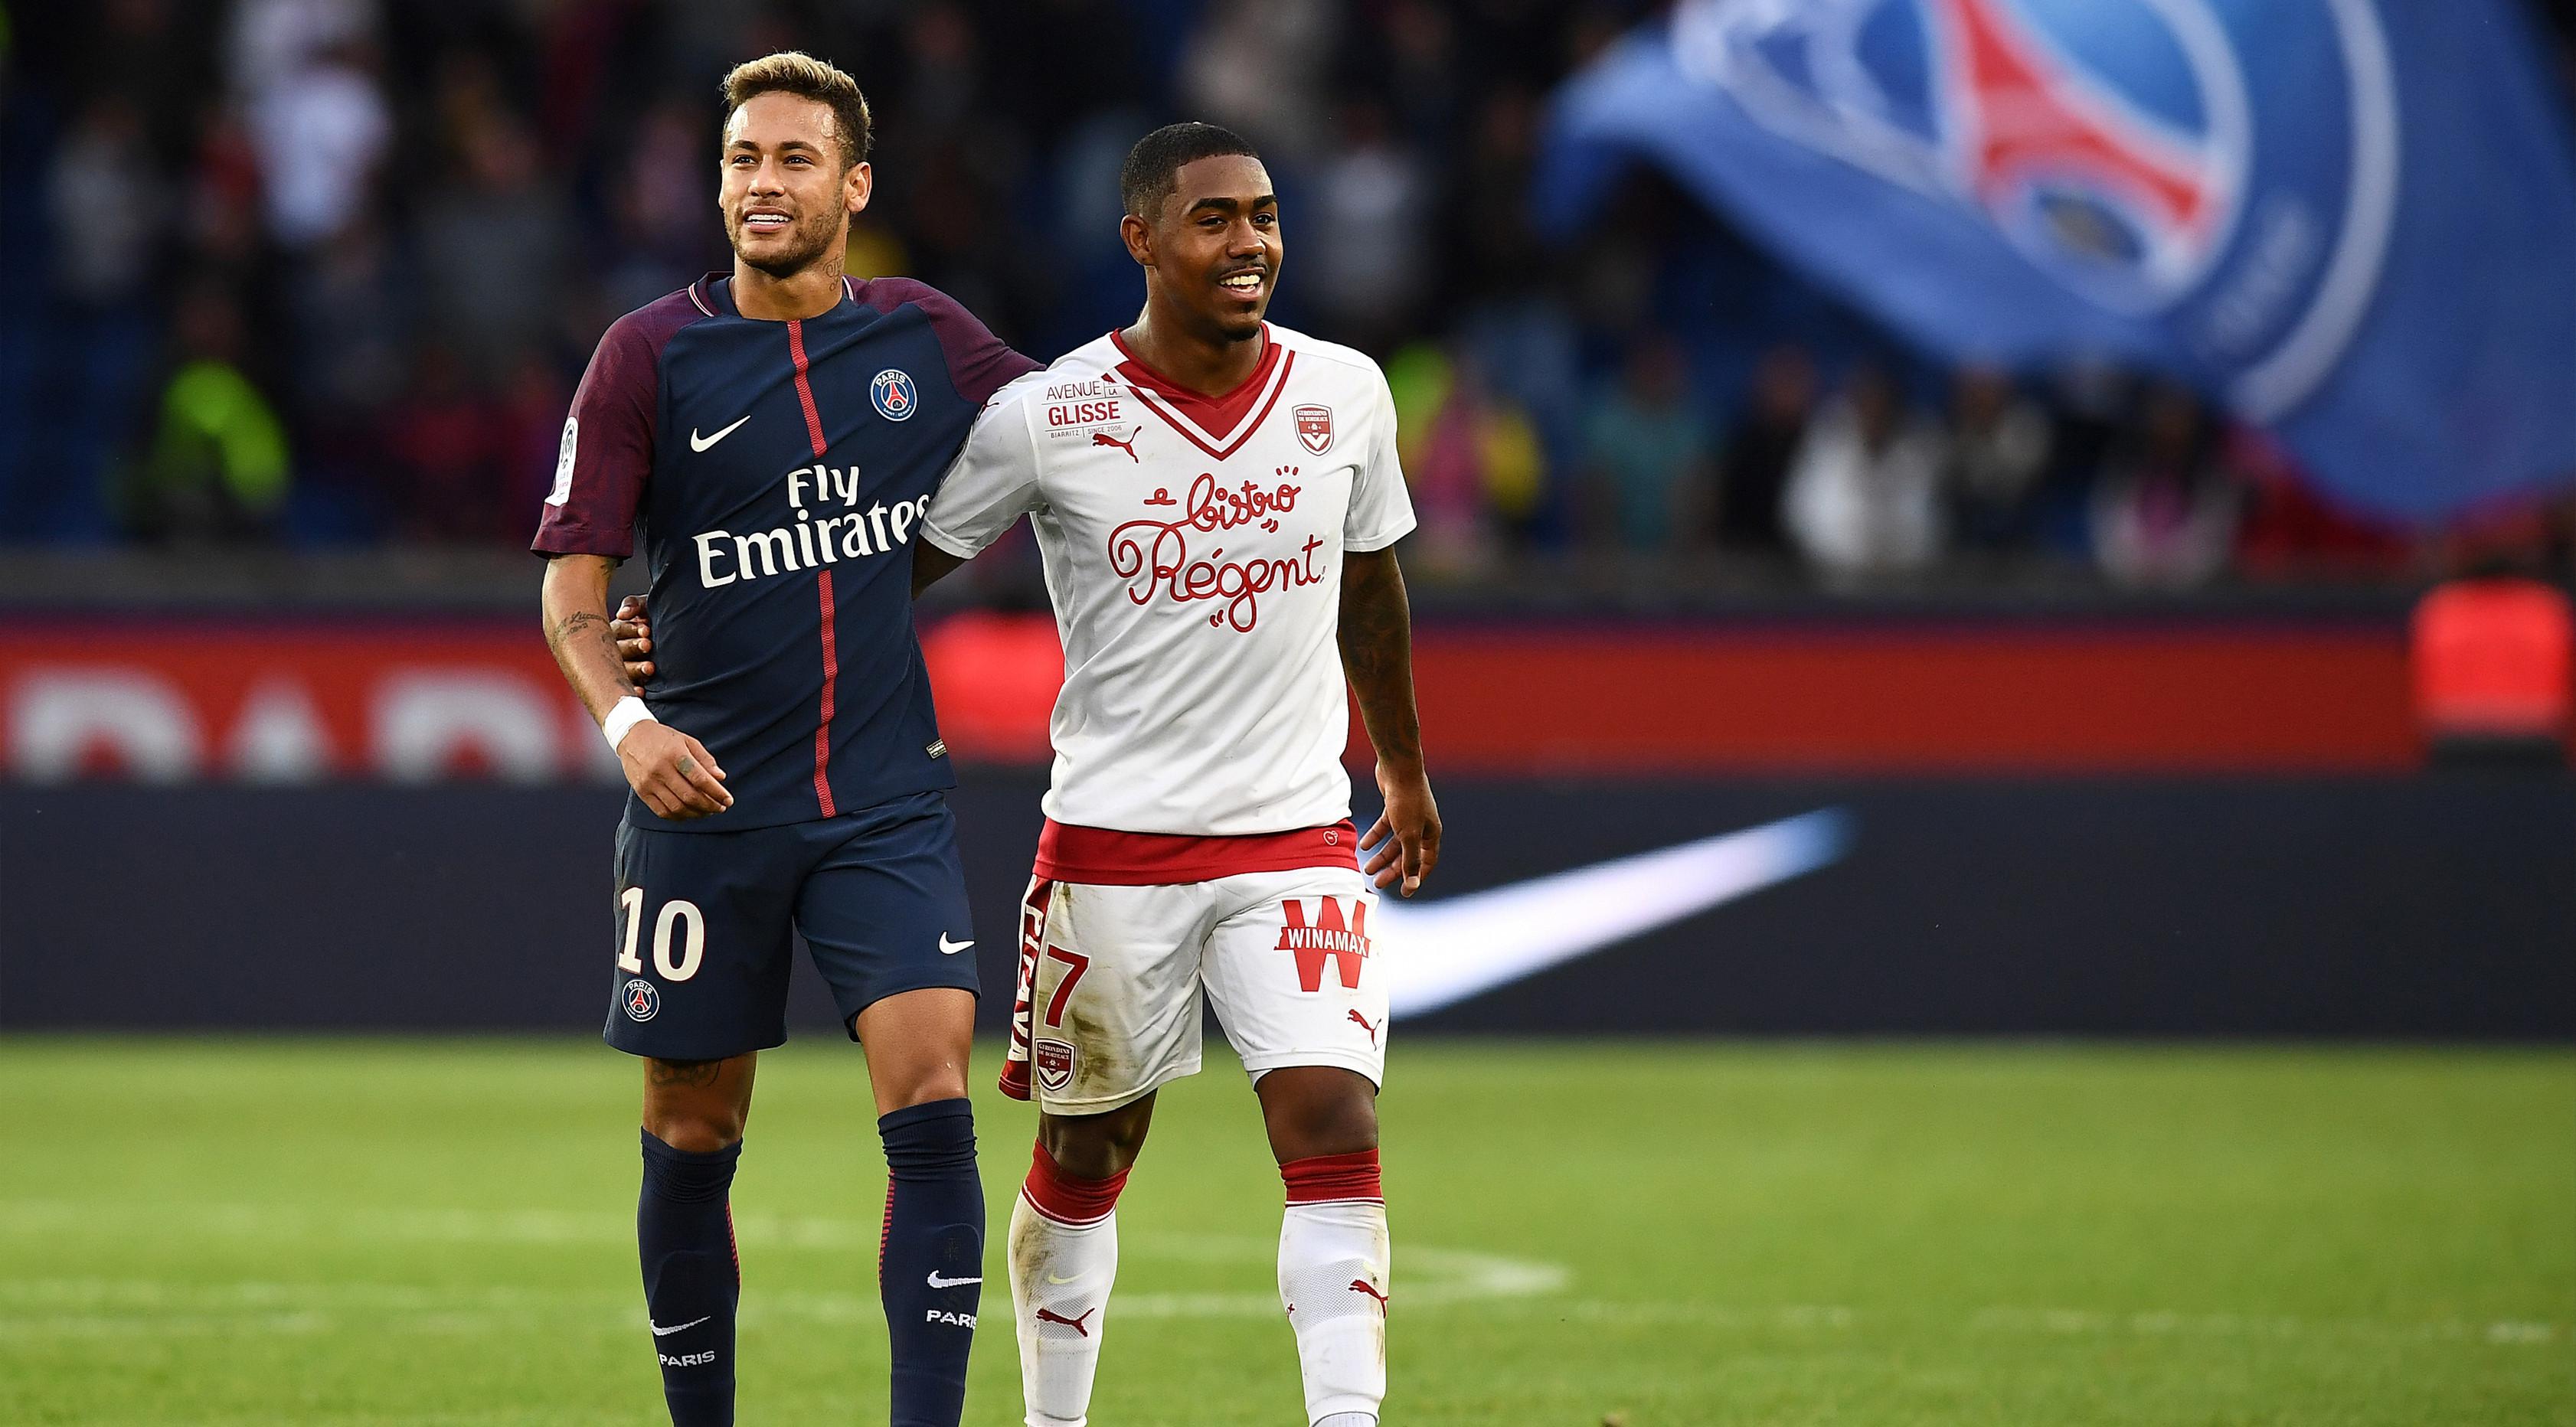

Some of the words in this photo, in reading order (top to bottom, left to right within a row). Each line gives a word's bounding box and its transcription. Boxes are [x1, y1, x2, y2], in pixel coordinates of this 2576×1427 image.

[875, 372, 906, 387] PARIS
[1046, 381, 1102, 400] AVENUE
[1048, 401, 1120, 426] GLISSE
[1051, 429, 1079, 439] BIARRITZ
[788, 464, 859, 508] Fly
[1187, 472, 1301, 531] bistro
[1108, 521, 1323, 632] Régent
[618, 887, 704, 981] 10
[1287, 928, 1368, 958] WINAMAX
[629, 982, 652, 994] PARIS
[1045, 944, 1090, 1030] 7
[659, 1350, 715, 1367] PARIS
